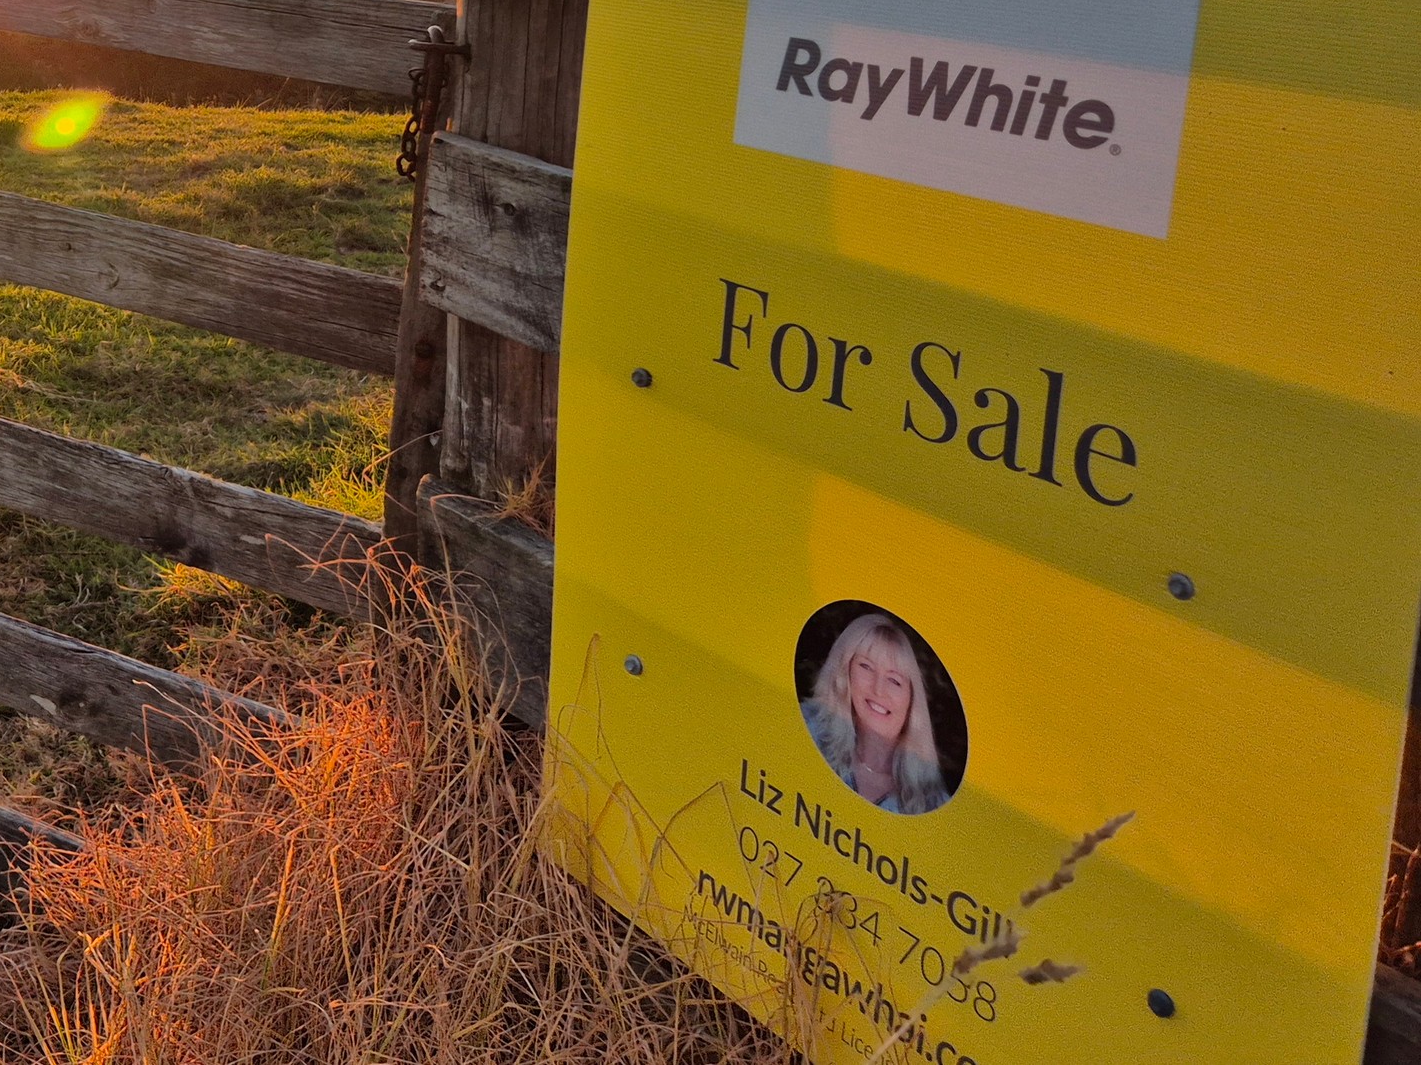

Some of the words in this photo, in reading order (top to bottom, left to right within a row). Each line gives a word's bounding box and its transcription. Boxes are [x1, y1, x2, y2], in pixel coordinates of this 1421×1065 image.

[713, 278, 873, 412] For
[902, 341, 1139, 507] Sale
[740, 758, 783, 816] Liz
[739, 826, 803, 887] 027
[696, 868, 977, 1065] rwmangawhai.c
